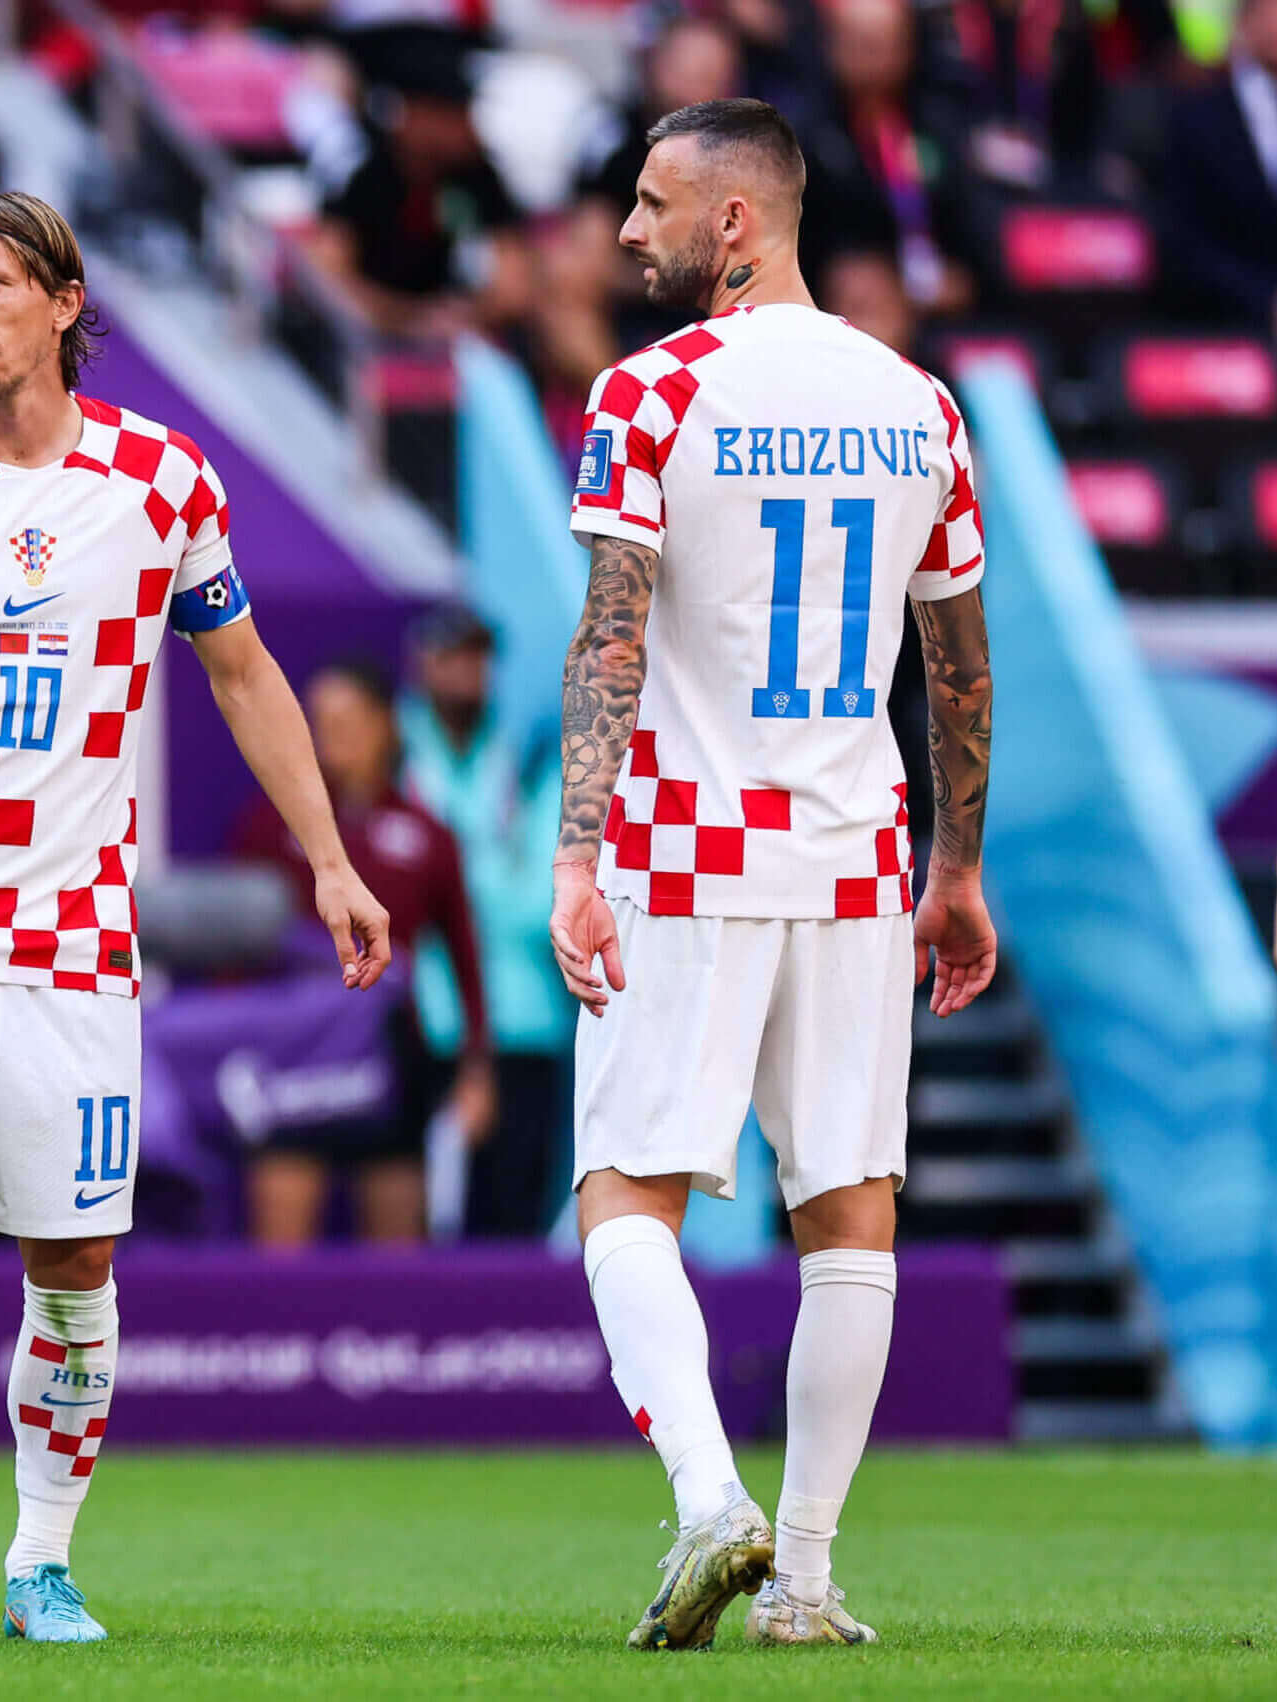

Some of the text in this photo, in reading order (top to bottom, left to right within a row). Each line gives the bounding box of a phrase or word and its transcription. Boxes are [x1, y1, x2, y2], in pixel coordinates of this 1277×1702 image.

[752, 498, 875, 718] 11
[74, 1096, 130, 1181] 10
[50, 1368, 109, 1388] HNS
